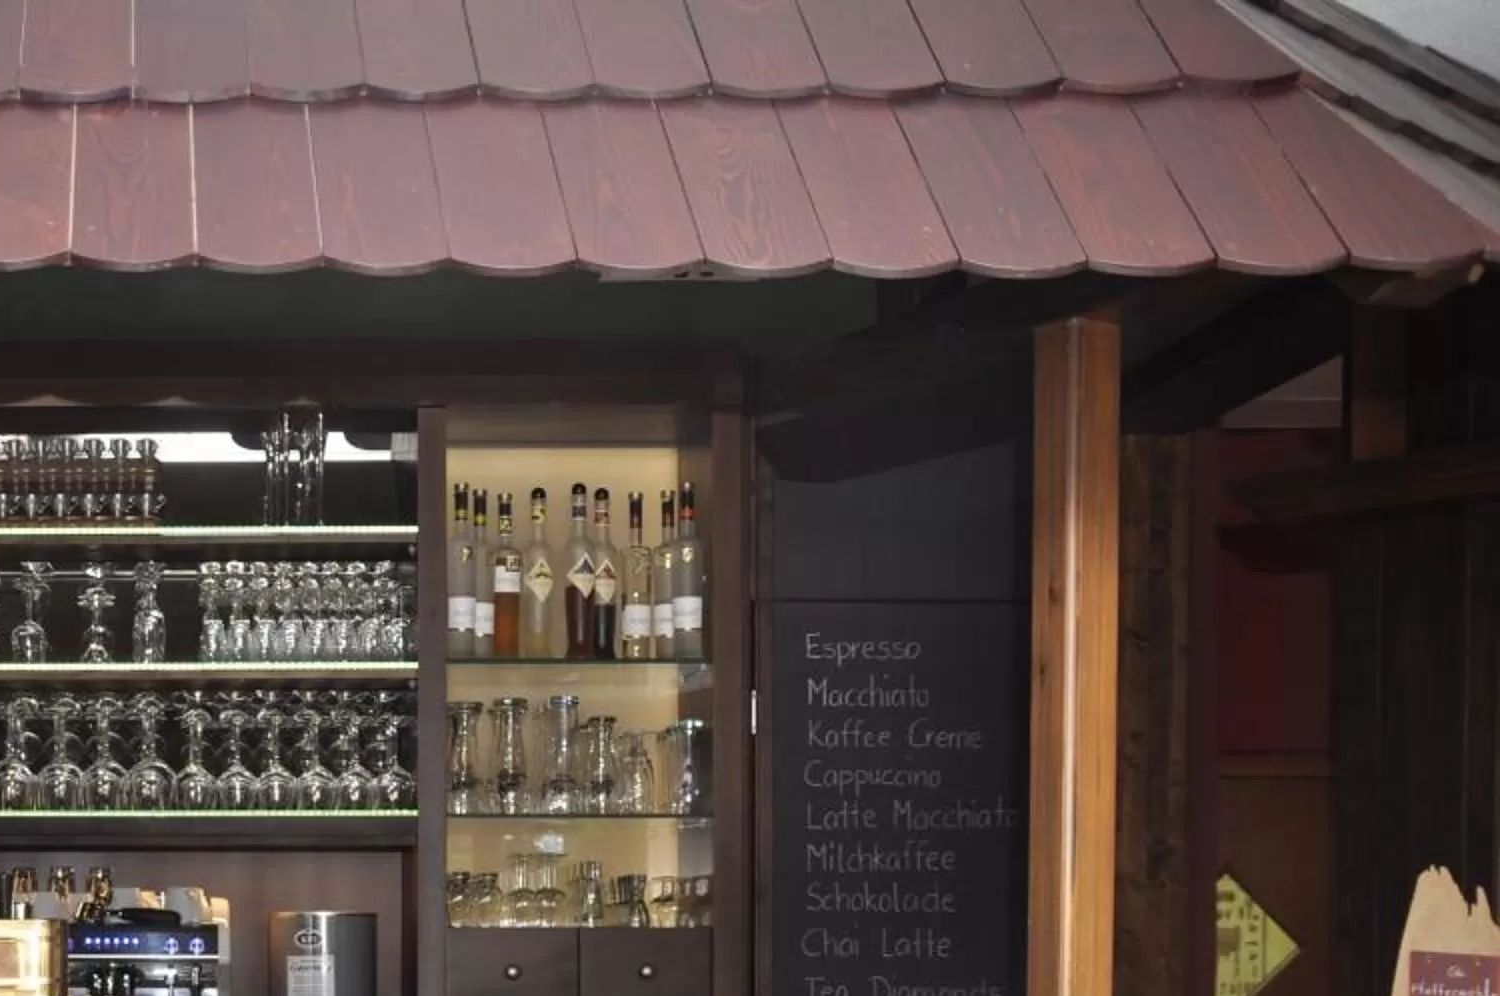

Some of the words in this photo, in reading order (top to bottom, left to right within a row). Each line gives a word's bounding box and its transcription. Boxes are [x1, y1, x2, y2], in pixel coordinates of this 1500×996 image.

[804, 631, 923, 667] Espresso
[806, 672, 930, 709] Macchiato
[807, 717, 893, 750] Kaffee
[802, 756, 943, 796] Cappuccino
[804, 800, 879, 831] Latte
[805, 838, 959, 874] Milchkaffee
[804, 879, 959, 914] Schokolade
[800, 922, 861, 961] Chai
[880, 926, 954, 960] Latte
